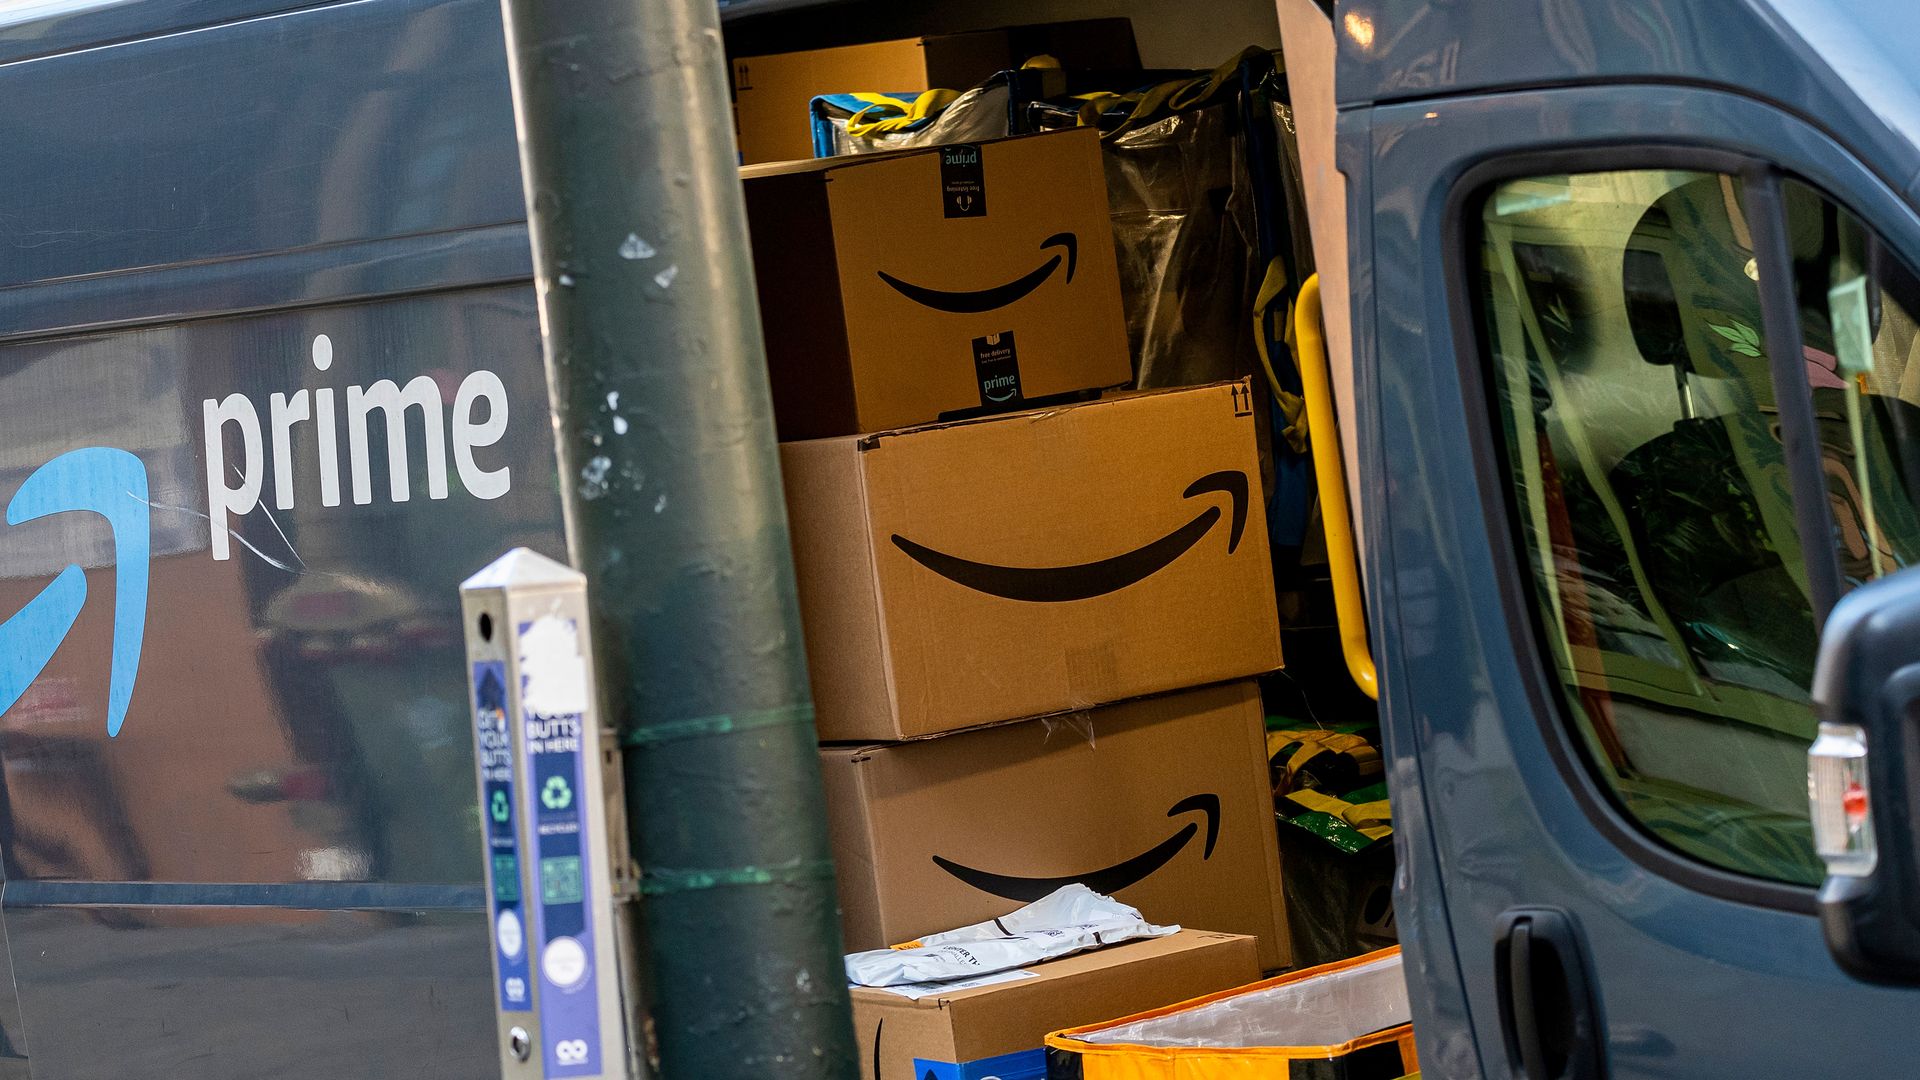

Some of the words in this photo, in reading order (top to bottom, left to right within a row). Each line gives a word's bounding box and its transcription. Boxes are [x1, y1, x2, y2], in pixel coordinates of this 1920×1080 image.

[945, 151, 977, 168] prime
[980, 351, 991, 359] free
[991, 348, 1011, 357] delivery
[984, 375, 1016, 394] prime
[203, 334, 510, 560] prime
[527, 718, 581, 739] BUTTS
